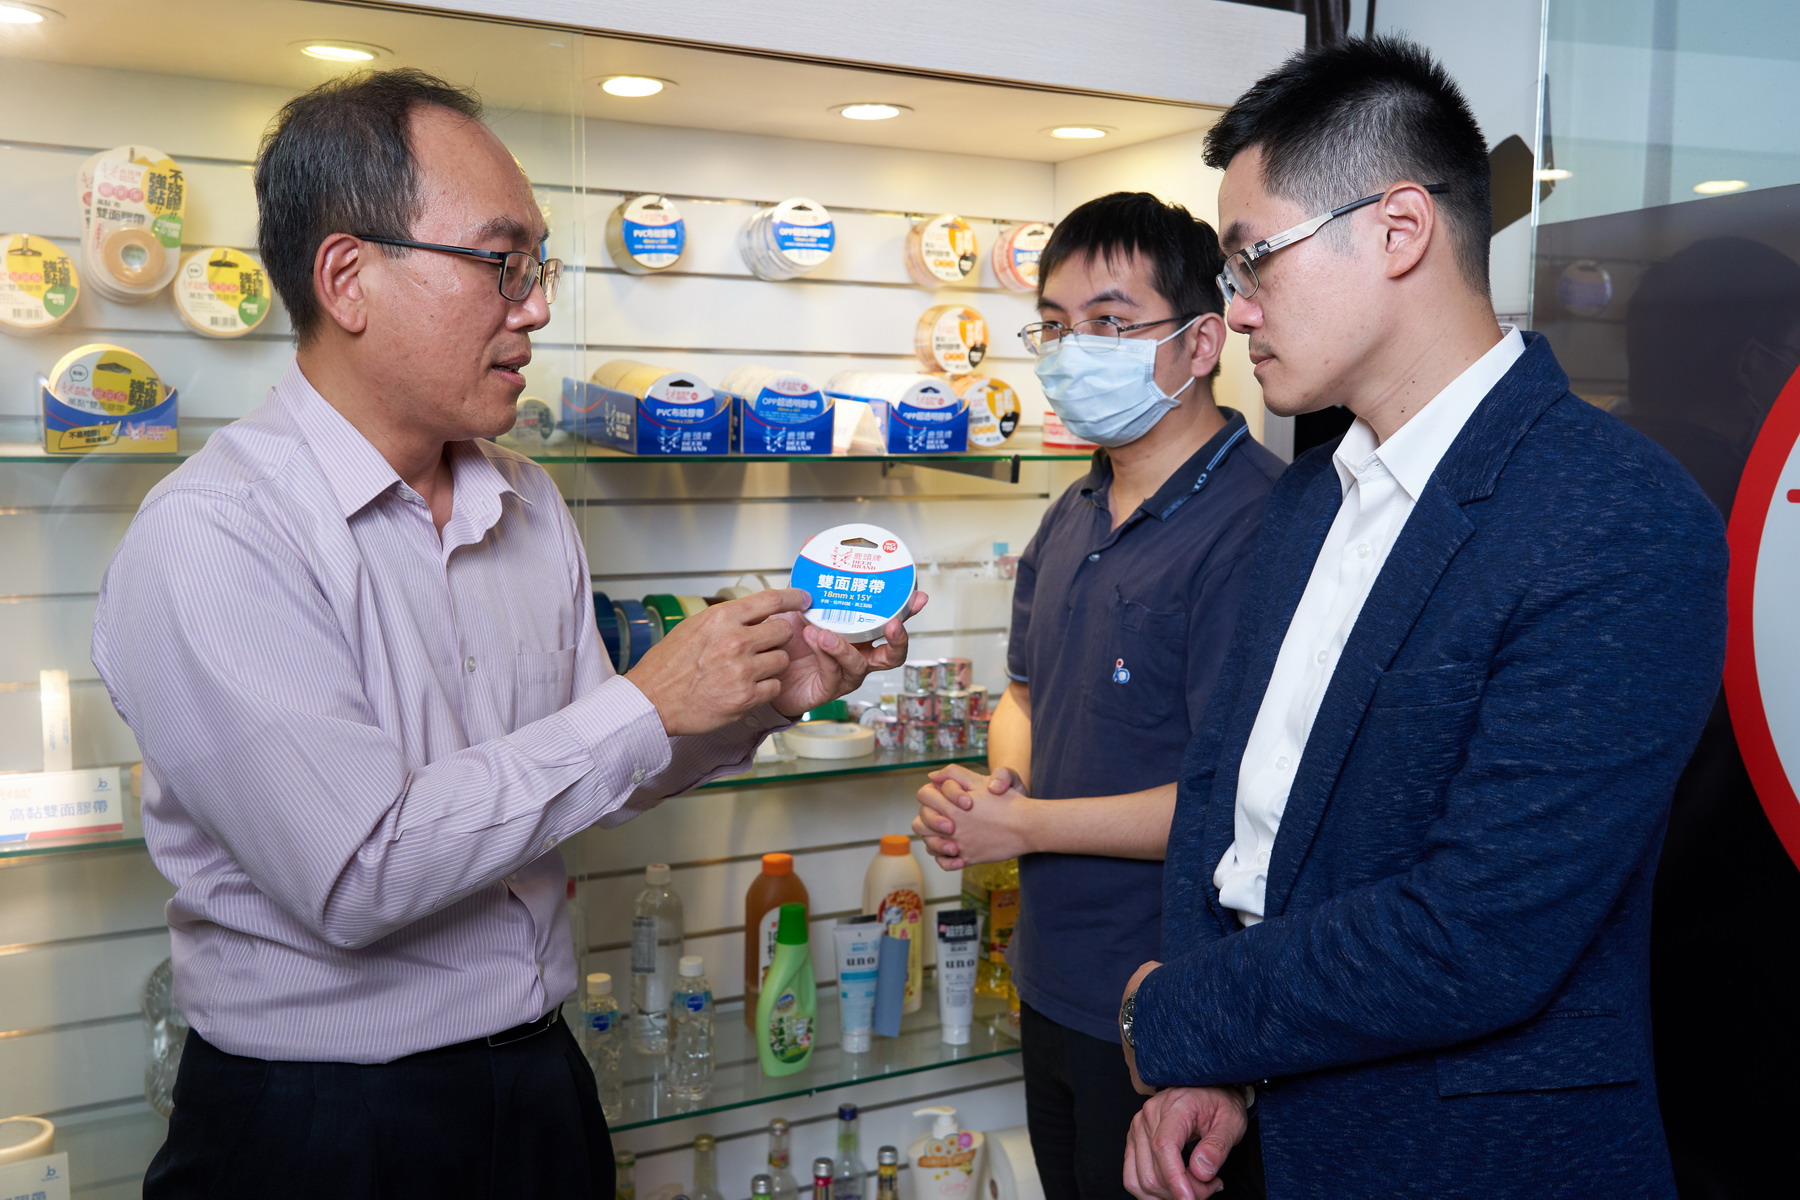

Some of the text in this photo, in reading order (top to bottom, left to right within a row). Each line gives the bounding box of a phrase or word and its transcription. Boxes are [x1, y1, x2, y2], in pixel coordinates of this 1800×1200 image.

[853, 552, 881, 562] 鹿頭牌
[817, 574, 886, 594] 雙面膠帶
[823, 590, 848, 600] 18mm
[857, 593, 872, 602] 15Y
[846, 956, 875, 966] uno
[945, 958, 975, 969] uno
